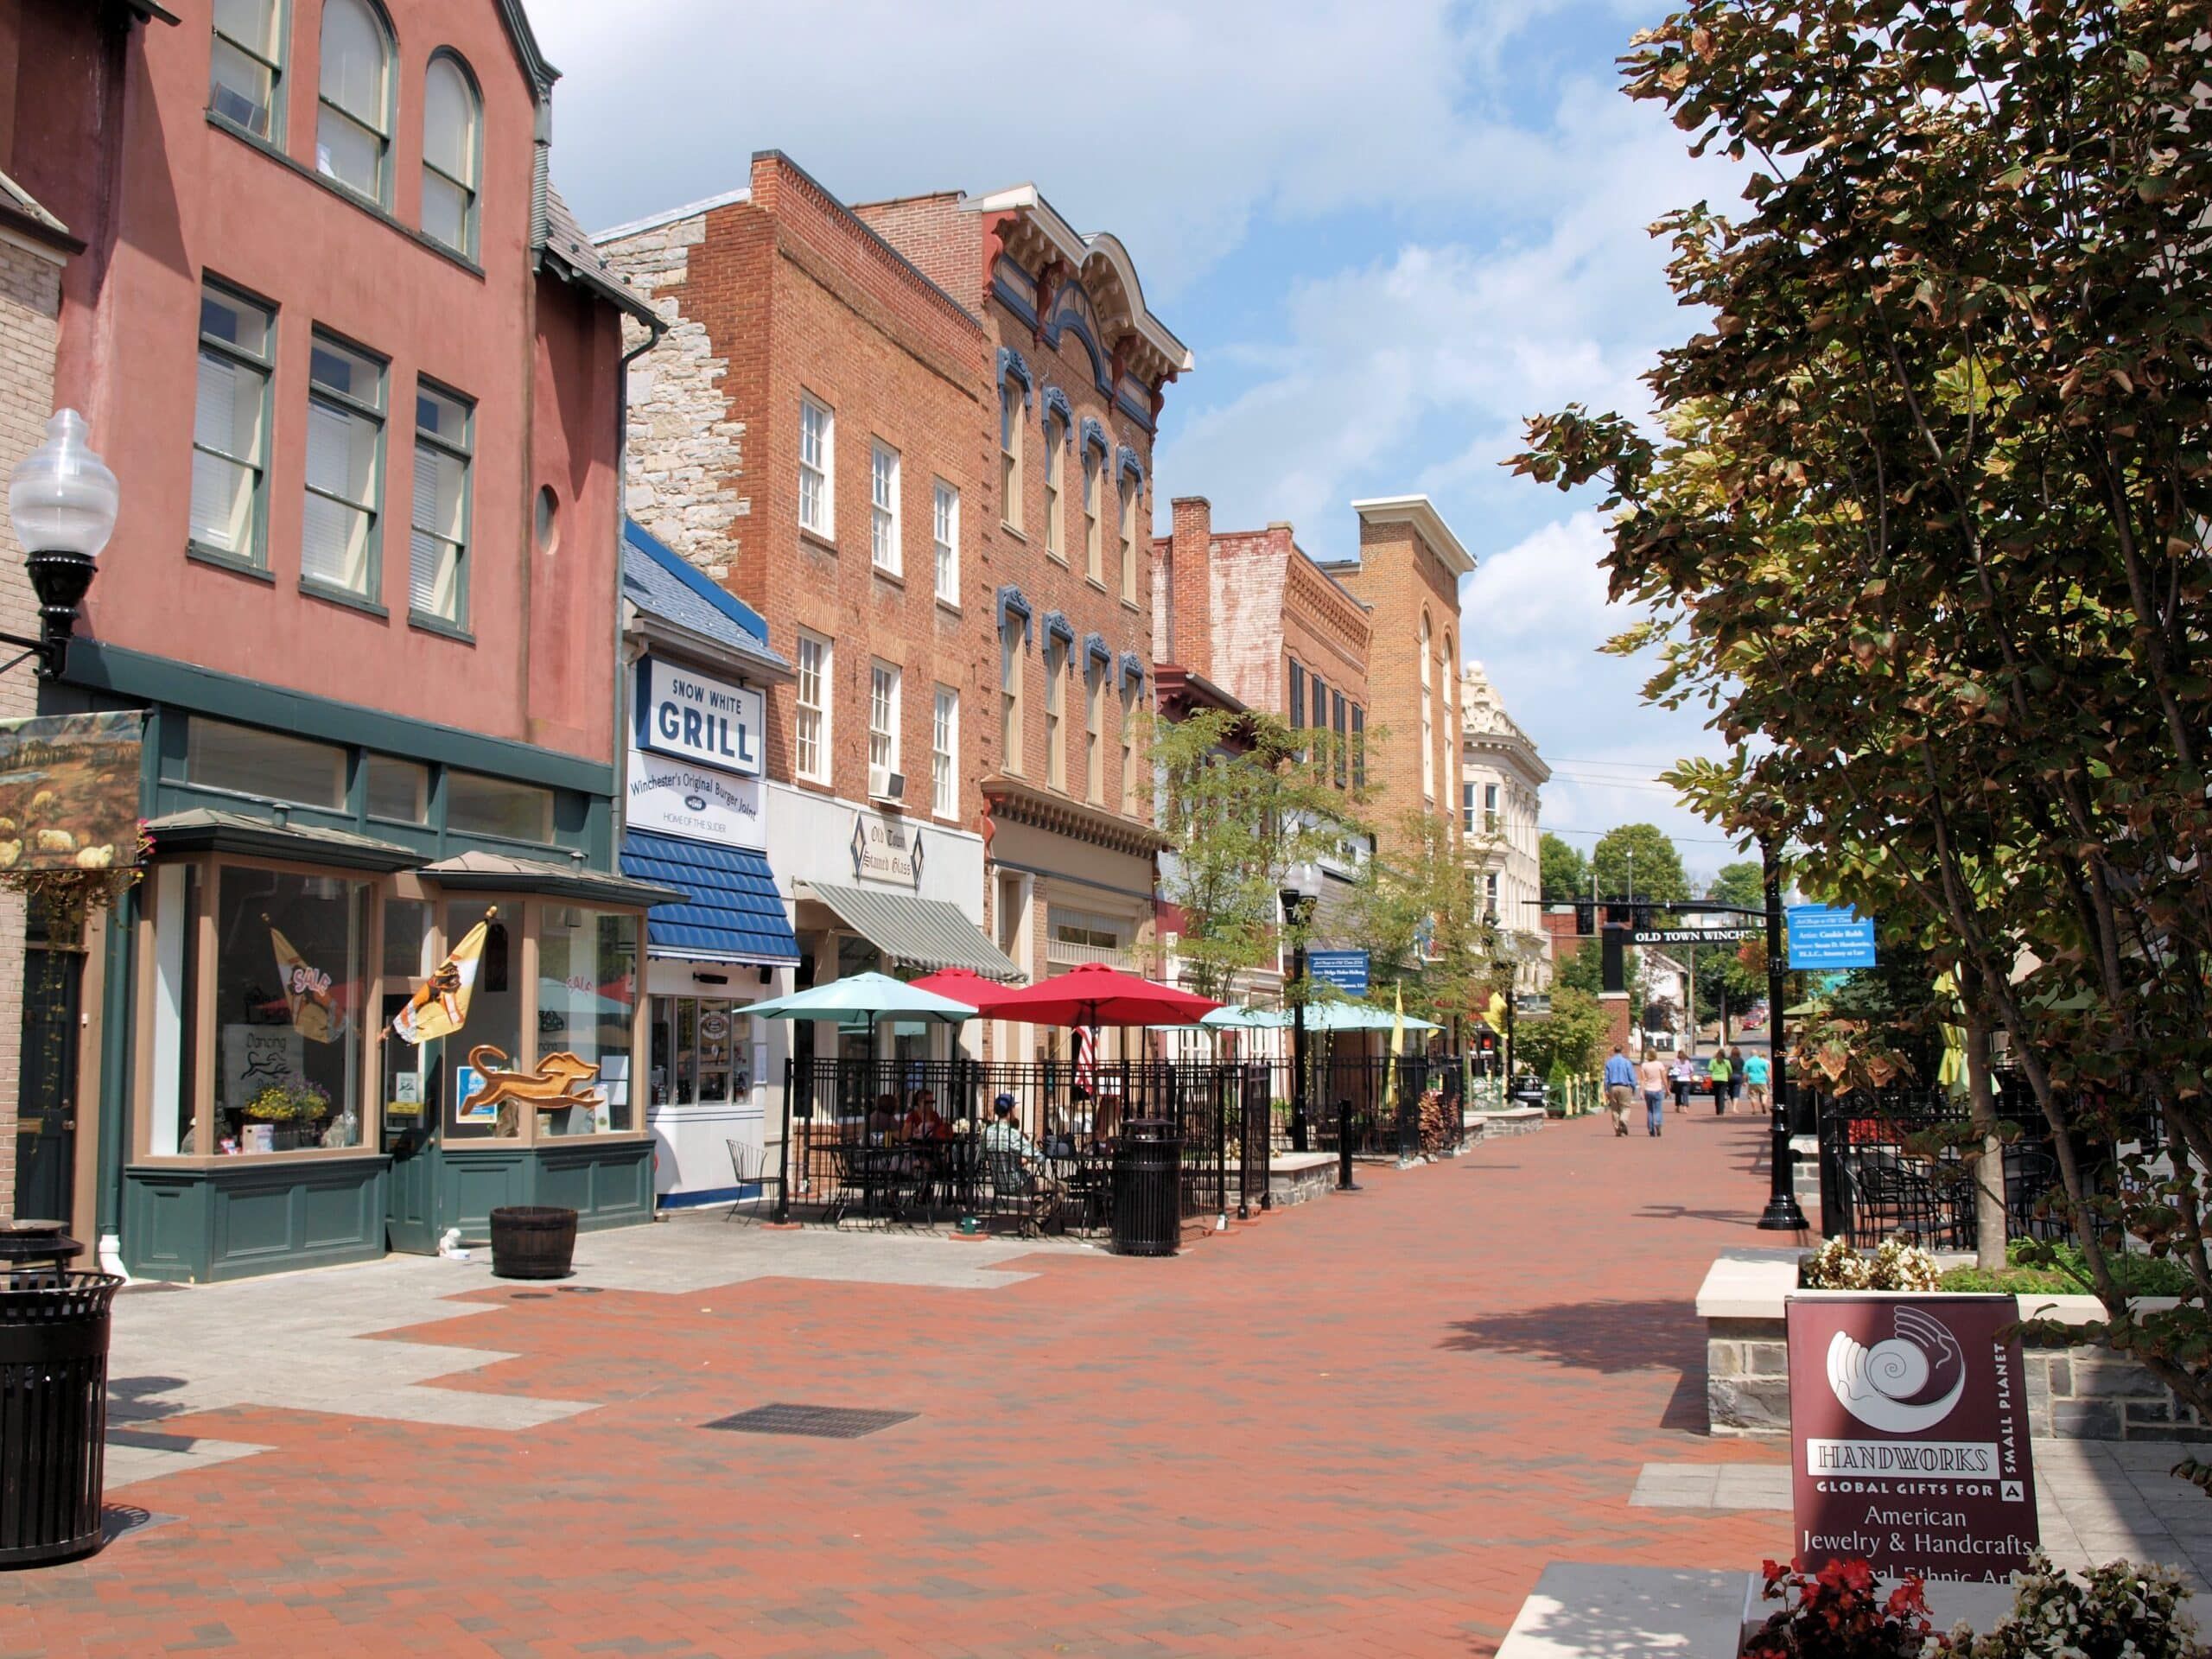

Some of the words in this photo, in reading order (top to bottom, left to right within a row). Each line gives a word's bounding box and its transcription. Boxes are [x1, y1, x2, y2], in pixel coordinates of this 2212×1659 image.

[672, 678, 704, 702] SNOW
[709, 690, 742, 715] WHITE
[658, 701, 753, 763] GRILL
[631, 772, 681, 797] Winchester's
[683, 772, 713, 792] Original
[715, 782, 738, 806] Burger
[739, 798, 756, 822] Joint
[663, 812, 683, 825] HOME
[683, 817, 692, 826] OF
[693, 818, 705, 830] THE
[707, 821, 727, 833] SLIDER
[871, 825, 884, 844] Old
[887, 829, 906, 849] Town
[864, 849, 889, 872] Stained
[891, 856, 911, 876] Glass
[1635, 932, 1661, 942] OLD
[1664, 931, 1700, 942] TOWN
[294, 967, 332, 997] SALE
[246, 1033, 287, 1053] Dancing
[1994, 1344, 2012, 1408] PLANET
[2000, 1416, 2017, 1473] SMALL
[1818, 1446, 1989, 1472] HANDWORKS
[1816, 1481, 1889, 1494] GLOBAL
[1897, 1483, 1948, 1496] GIFTS
[1956, 1484, 1993, 1497] FOR
[2005, 1485, 2020, 1497] A
[1865, 1506, 1966, 1527] American
[1804, 1530, 1880, 1558] Jewelry
[1889, 1532, 1906, 1553] &
[1915, 1534, 2032, 1556] Handcrafts
